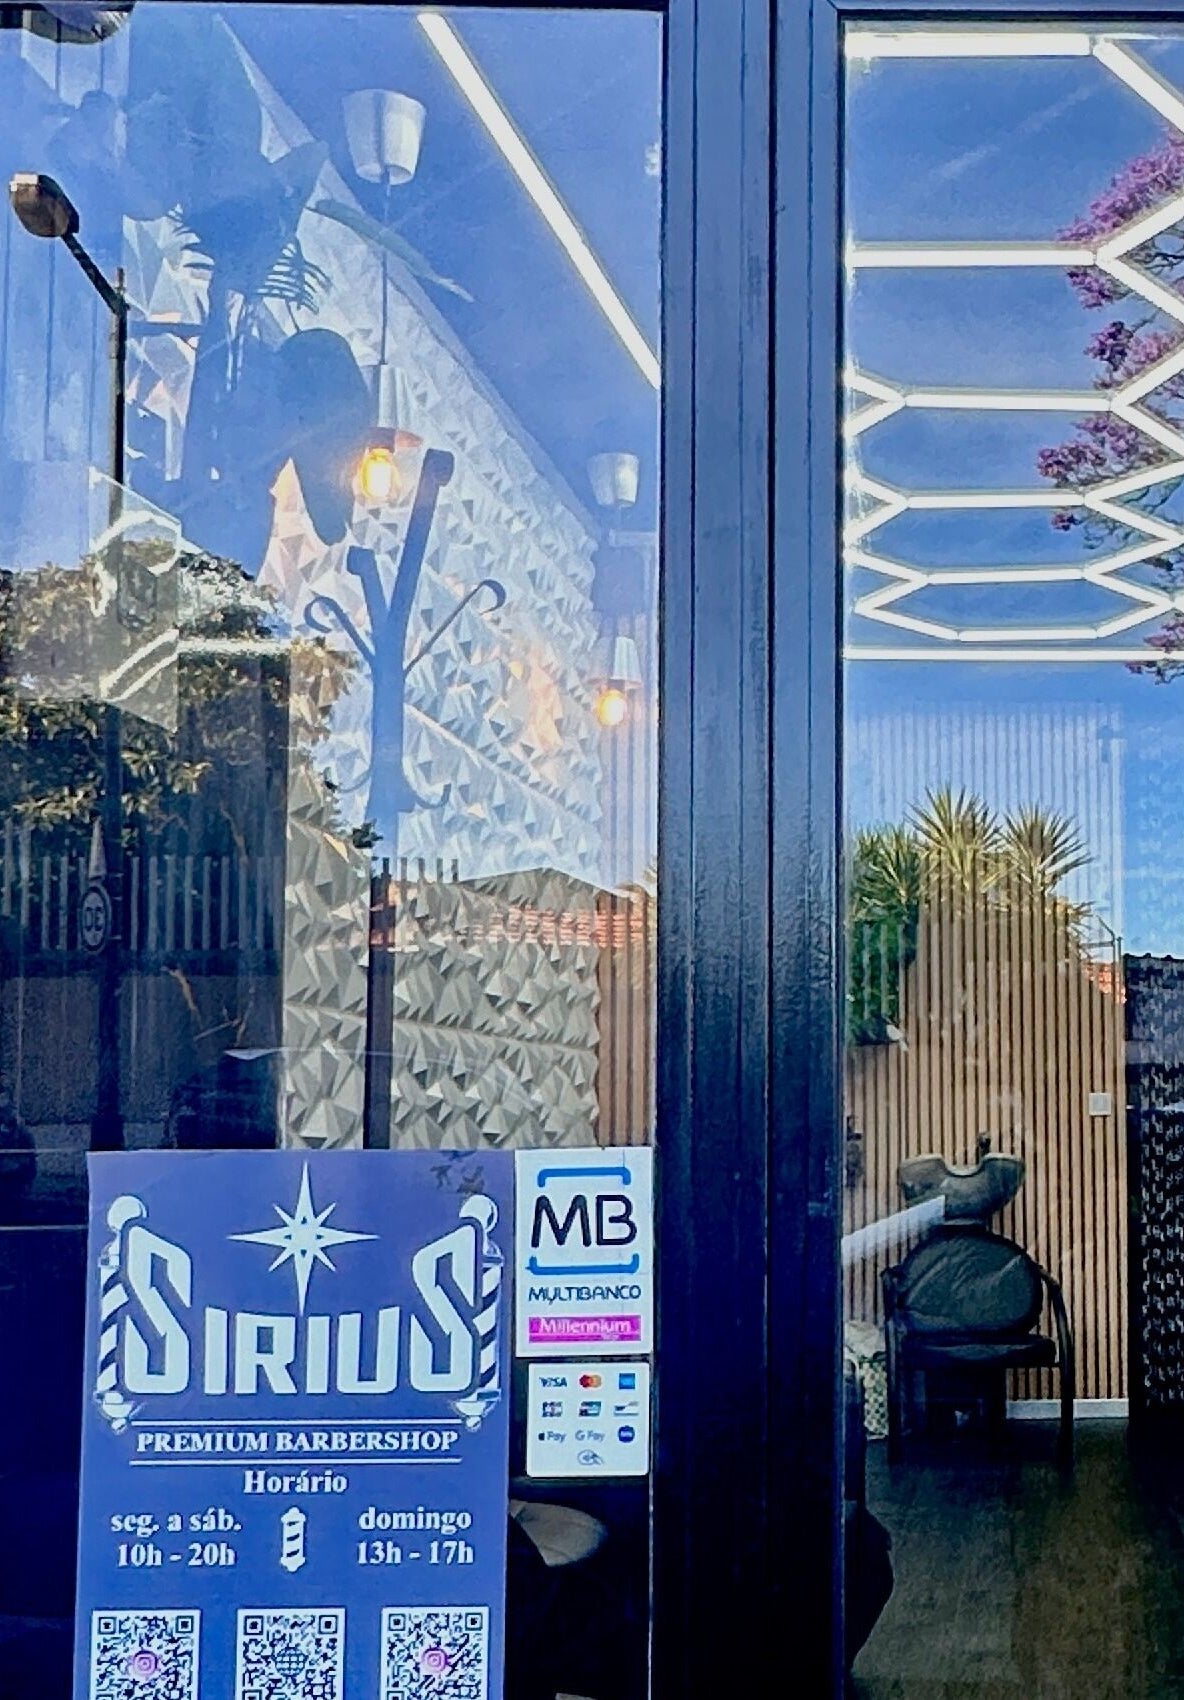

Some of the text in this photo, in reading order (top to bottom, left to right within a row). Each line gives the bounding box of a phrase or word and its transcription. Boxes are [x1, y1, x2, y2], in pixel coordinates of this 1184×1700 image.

[531, 1194, 638, 1248] MB
[528, 1285, 642, 1302] MULTIBANCO
[124, 1222, 477, 1395] SIRIUS
[540, 1318, 632, 1333] Millennium
[136, 1430, 458, 1453] PREMIUM BARBERSHOP
[546, 1431, 566, 1443] Pay
[587, 1430, 605, 1443] Pay
[243, 1469, 348, 1494] Horário
[110, 1508, 242, 1538] seg. a sáb.
[358, 1506, 473, 1536] domingo
[116, 1543, 162, 1568] 10h
[188, 1542, 236, 1567] 20h
[357, 1541, 402, 1565] 13h
[428, 1540, 474, 1565] 17h
